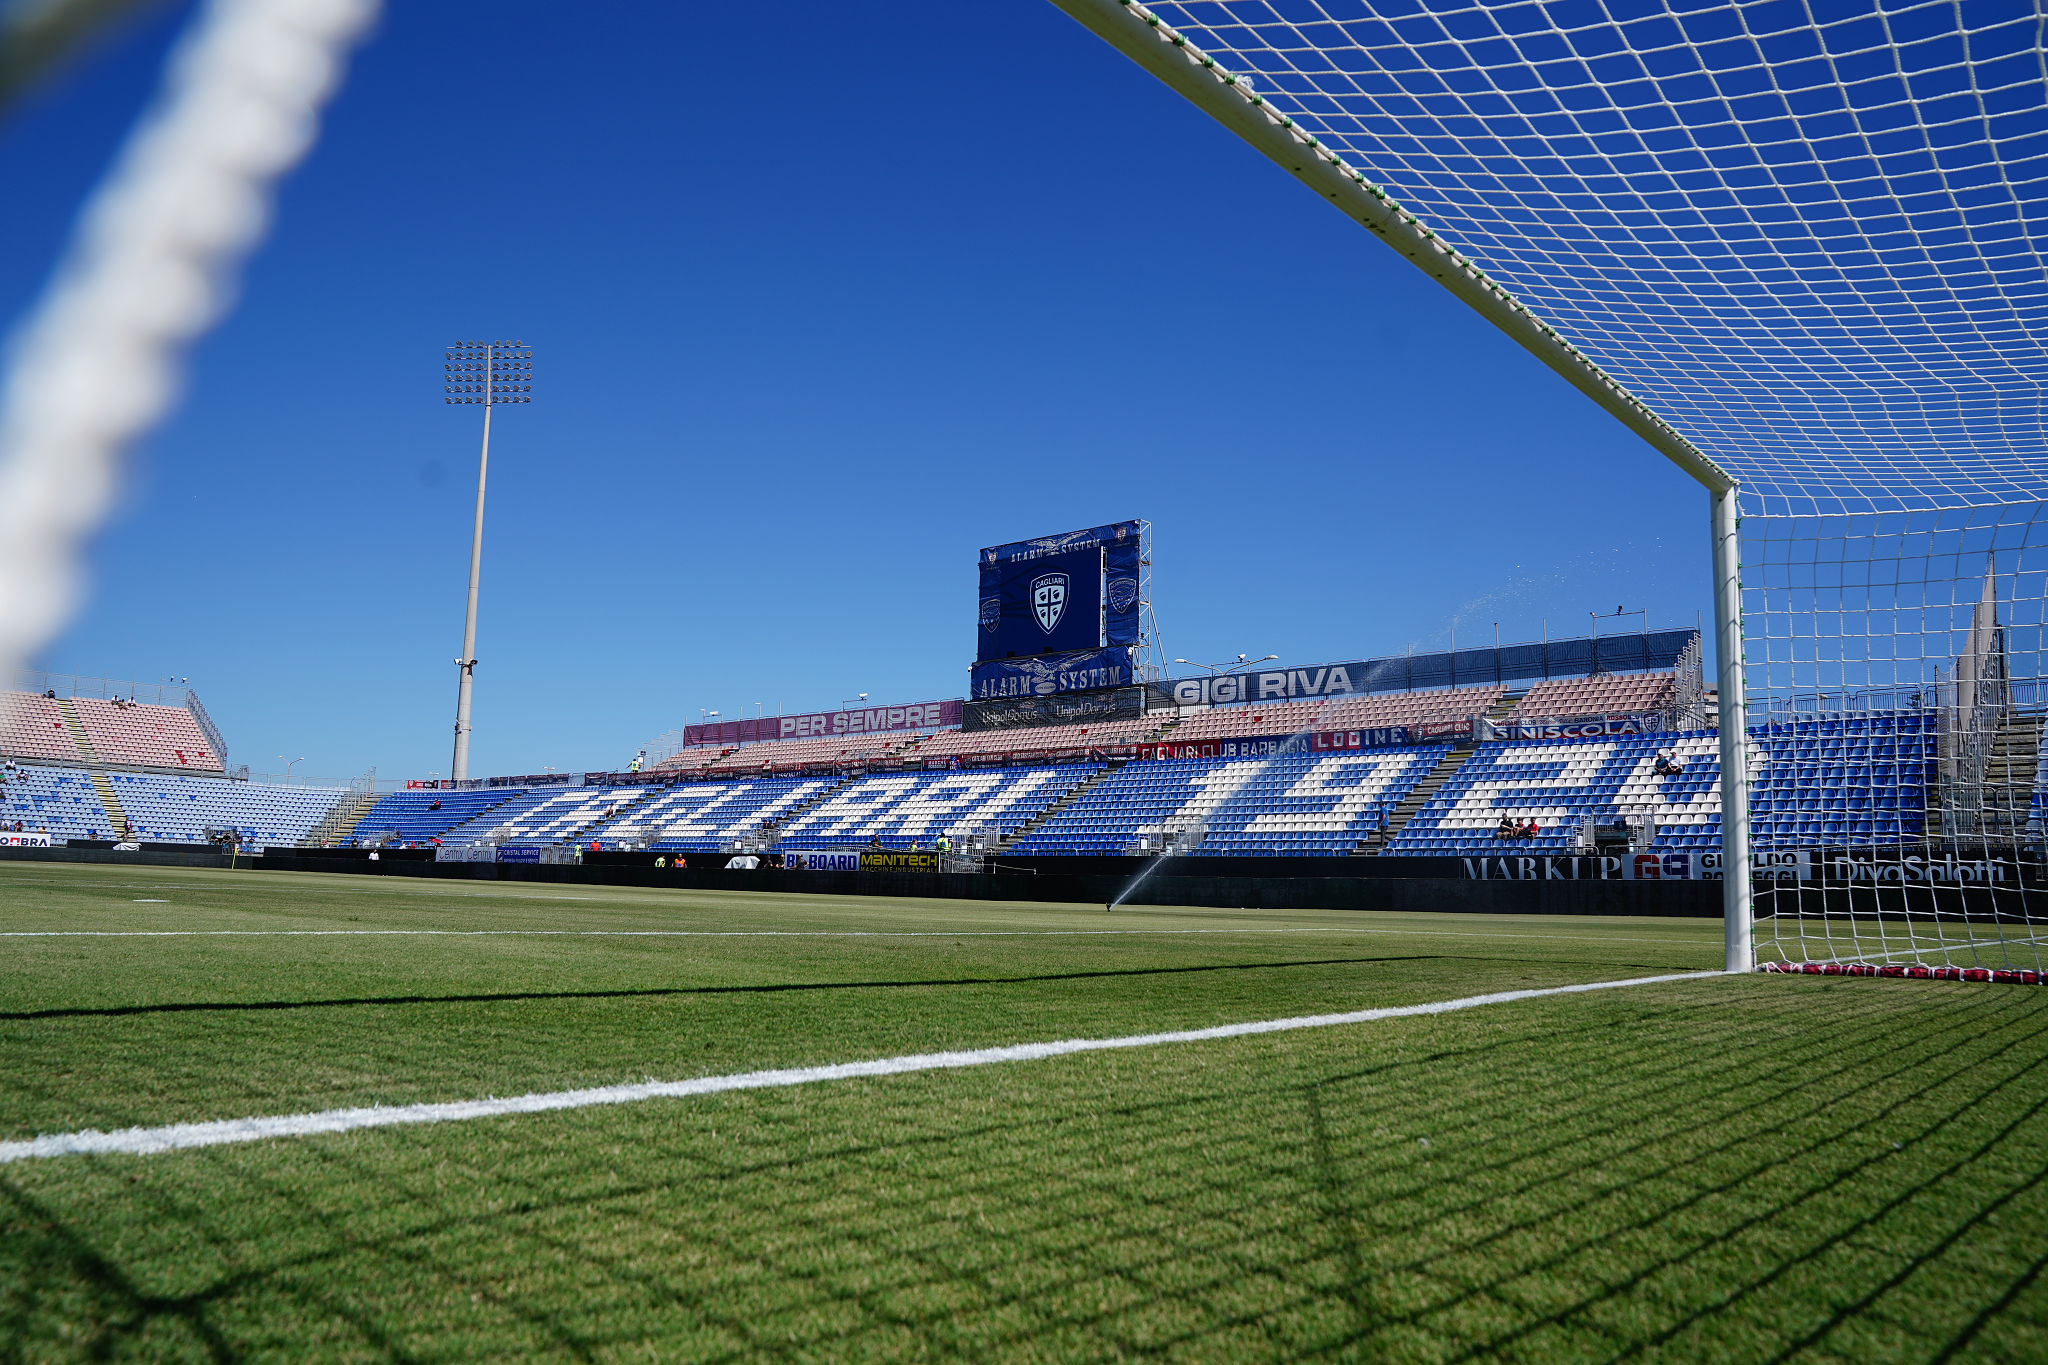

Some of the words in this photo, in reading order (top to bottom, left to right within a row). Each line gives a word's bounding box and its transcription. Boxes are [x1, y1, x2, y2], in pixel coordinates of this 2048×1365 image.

[1011, 550, 1044, 563] ALARM
[1062, 538, 1101, 554] SYSTEM
[1035, 577, 1065, 589] CAGLIARI
[980, 675, 1031, 698] ALARM
[1059, 665, 1122, 691] SYSTEM
[1174, 674, 1247, 705] GIGI
[1259, 666, 1354, 699] RIVA
[780, 713, 827, 738] PER
[832, 703, 942, 734] SEMPRE
[1495, 721, 1640, 740] SINISCOLA
[1142, 745, 1199, 761] CAGLIARI
[1202, 742, 1237, 759] CLUB
[1317, 727, 1403, 749] LODINE
[809, 854, 857, 871] BOARD
[1462, 856, 1621, 880] MARKUP
[1834, 853, 2004, 881] DivaSalotti
